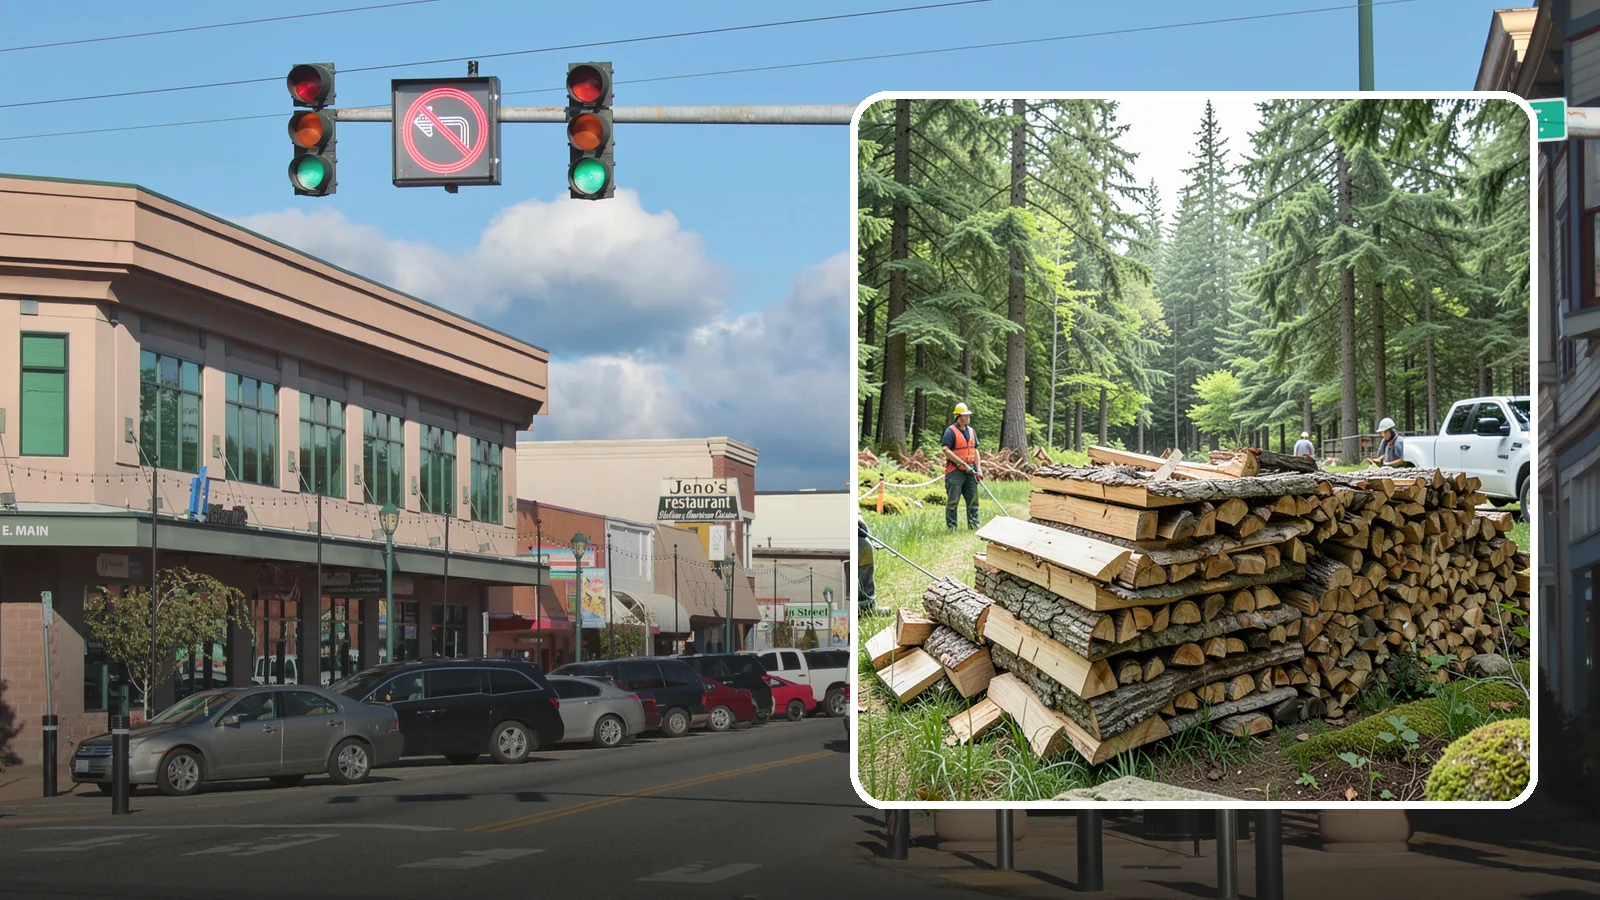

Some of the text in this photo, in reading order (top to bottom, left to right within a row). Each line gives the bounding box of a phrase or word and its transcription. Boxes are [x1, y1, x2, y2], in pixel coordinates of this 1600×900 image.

[669, 480, 727, 495] Jeno's
[665, 496, 730, 508] restaurant
[658, 509, 681, 520] Italian
[686, 509, 715, 520] American
[715, 509, 738, 520] Cuisine
[2, 525, 49, 537] E. MAIN
[797, 607, 828, 616] Street
